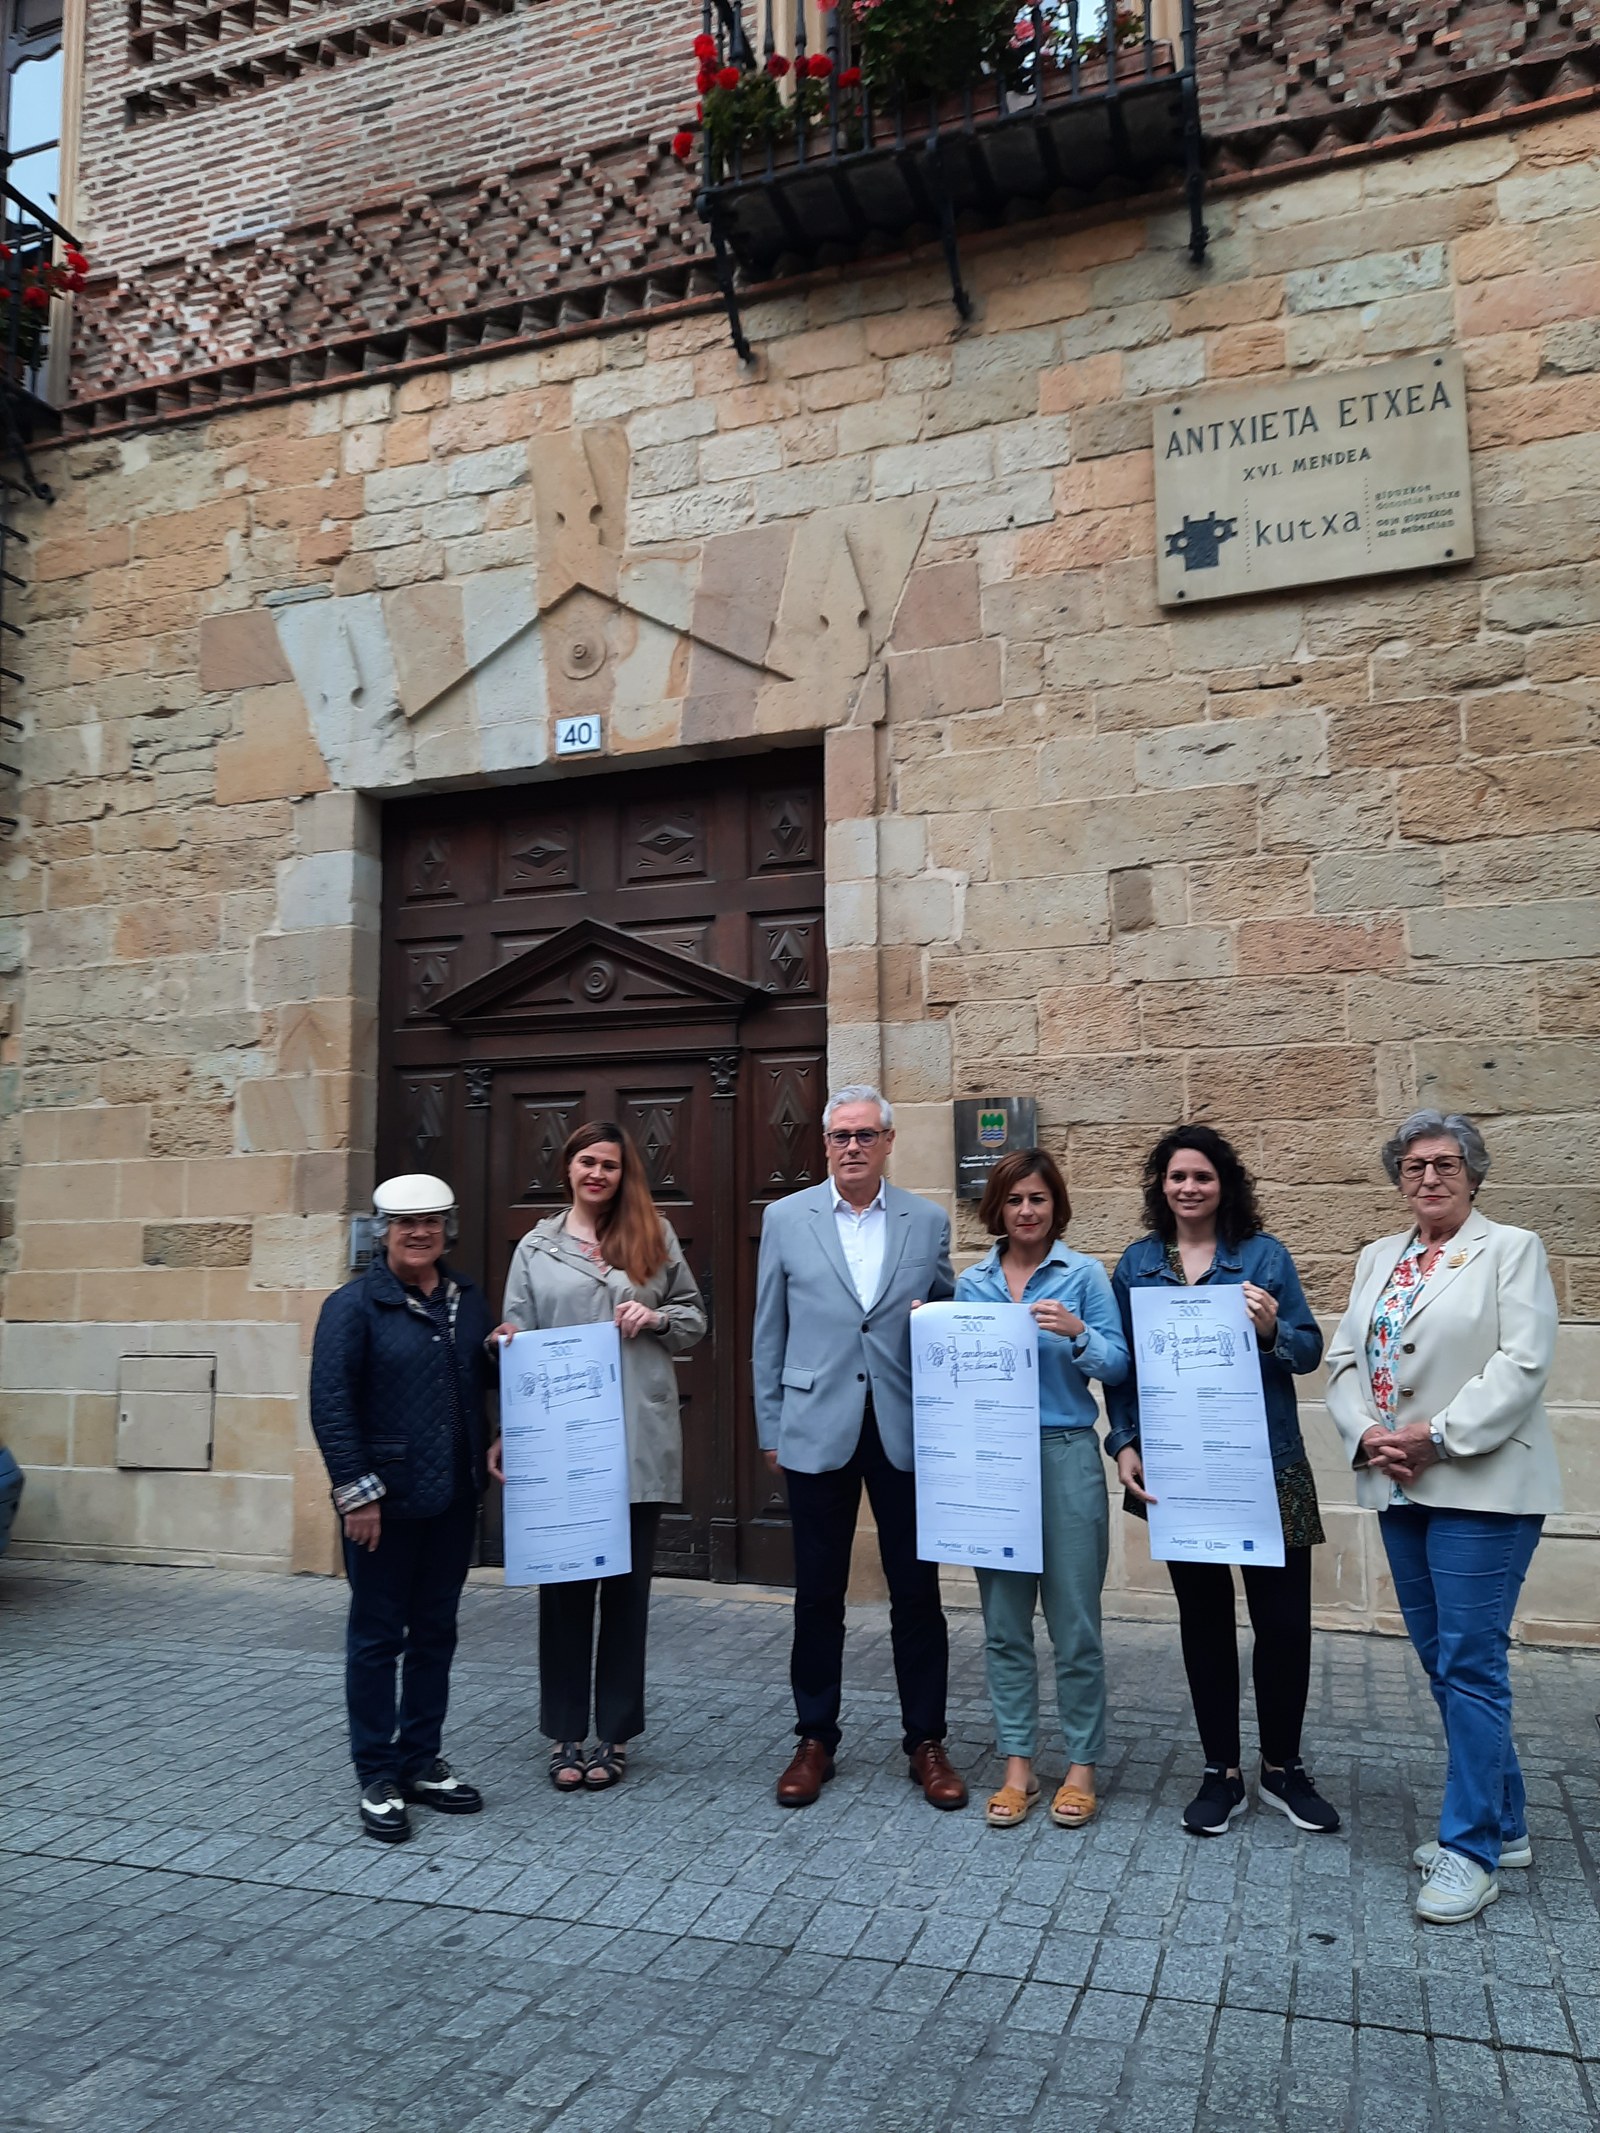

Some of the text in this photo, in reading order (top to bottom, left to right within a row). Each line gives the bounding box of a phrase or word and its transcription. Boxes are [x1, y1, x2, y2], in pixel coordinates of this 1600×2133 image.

[1165, 380, 1452, 460] ANTXIETA ETXEA
[1242, 447, 1372, 482] XVI. MENDEA
[1255, 511, 1361, 547] kutxa
[563, 722, 592, 746] 40
